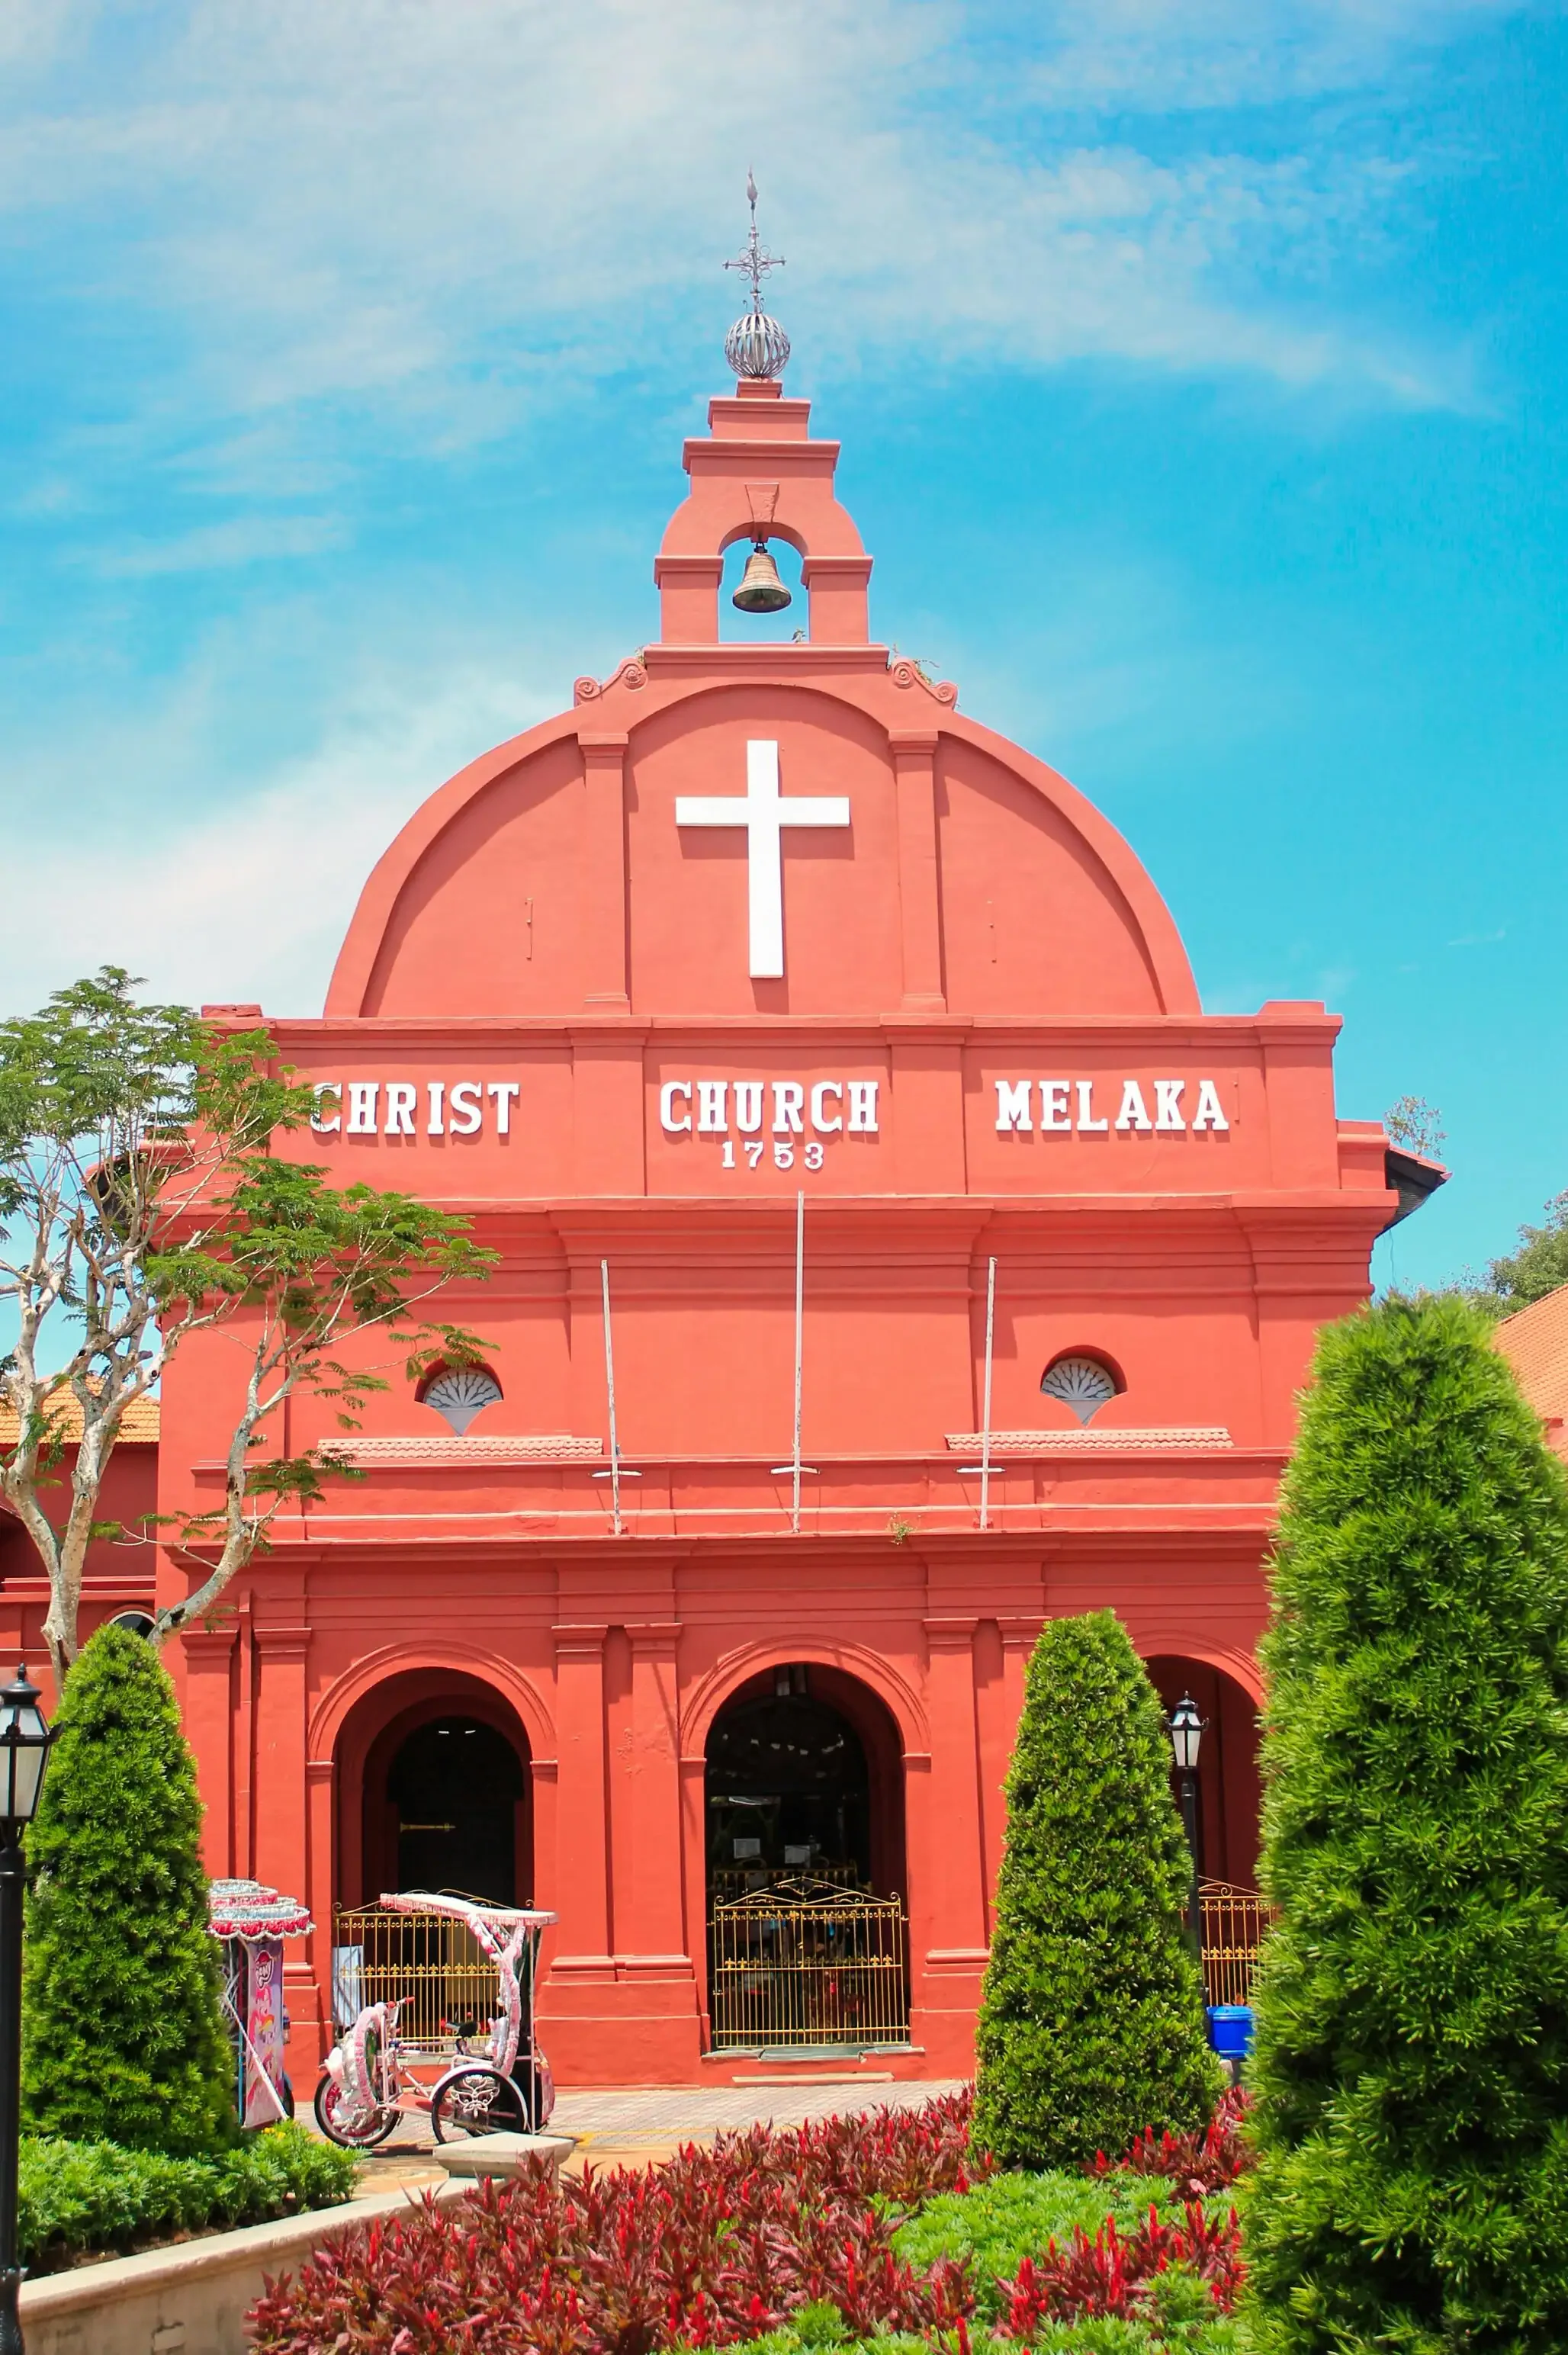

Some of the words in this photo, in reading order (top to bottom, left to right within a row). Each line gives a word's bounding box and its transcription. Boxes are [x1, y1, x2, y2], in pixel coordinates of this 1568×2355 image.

[310, 1081, 519, 1134] CHRIST
[660, 1081, 879, 1133] CHURCH
[994, 1080, 1229, 1131] MELAKA
[722, 1141, 824, 1170] 1753
